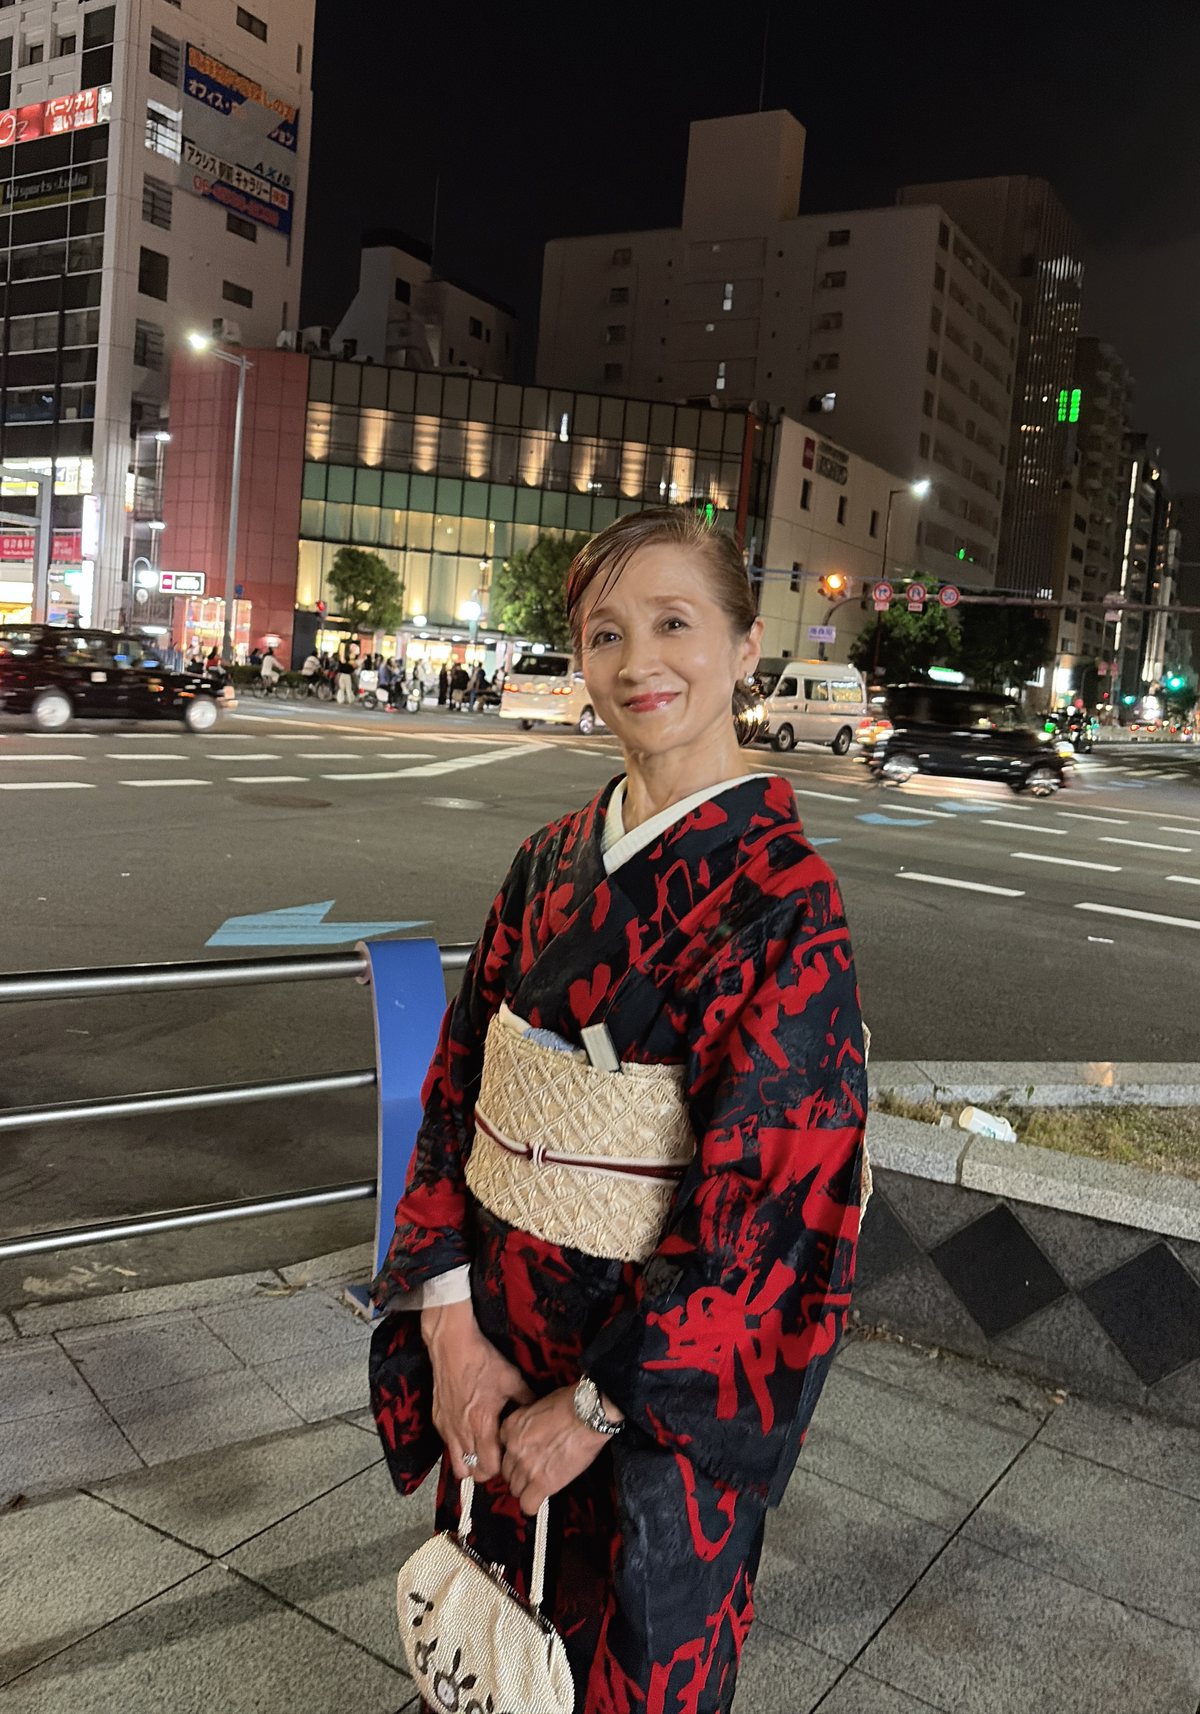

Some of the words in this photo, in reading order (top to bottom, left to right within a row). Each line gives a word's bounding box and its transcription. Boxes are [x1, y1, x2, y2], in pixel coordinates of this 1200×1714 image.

[45, 91, 95, 117] パーソナル
